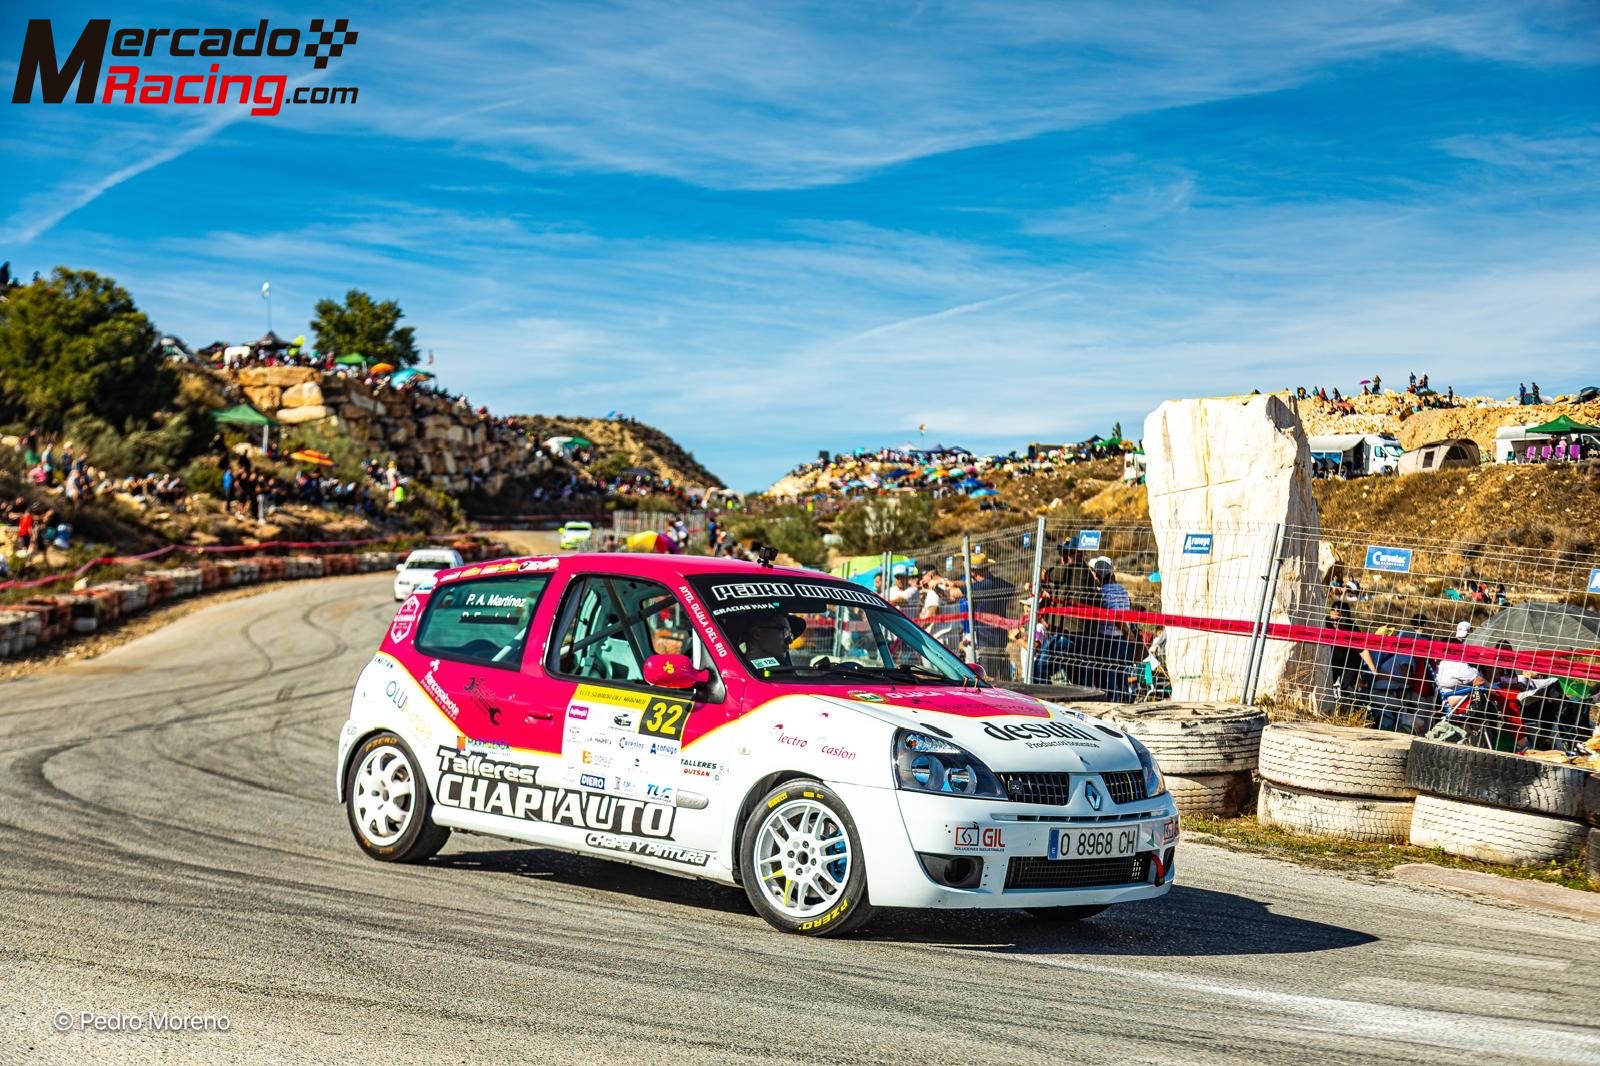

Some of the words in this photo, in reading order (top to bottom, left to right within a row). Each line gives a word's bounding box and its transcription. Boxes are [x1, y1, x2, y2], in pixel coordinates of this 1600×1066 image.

[465, 593, 475, 606] P.
[475, 594, 485, 606] A.
[486, 593, 528, 607] Martínez
[711, 583, 795, 601] PEDRO
[712, 604, 751, 616] GRACIAS
[691, 602, 709, 628] OLULA
[704, 626, 718, 643] DEL
[714, 641, 728, 658] RIO
[645, 702, 683, 735] 32
[438, 747, 536, 784] Talleres
[680, 758, 717, 769] TALLERES
[683, 768, 711, 777] QUISAN
[581, 774, 604, 788] DIERO
[438, 773, 675, 838] CHAPIAUTO
[982, 828, 1006, 848] GIL
[1077, 832, 1113, 855] 8968
[1118, 830, 1136, 854] CH
